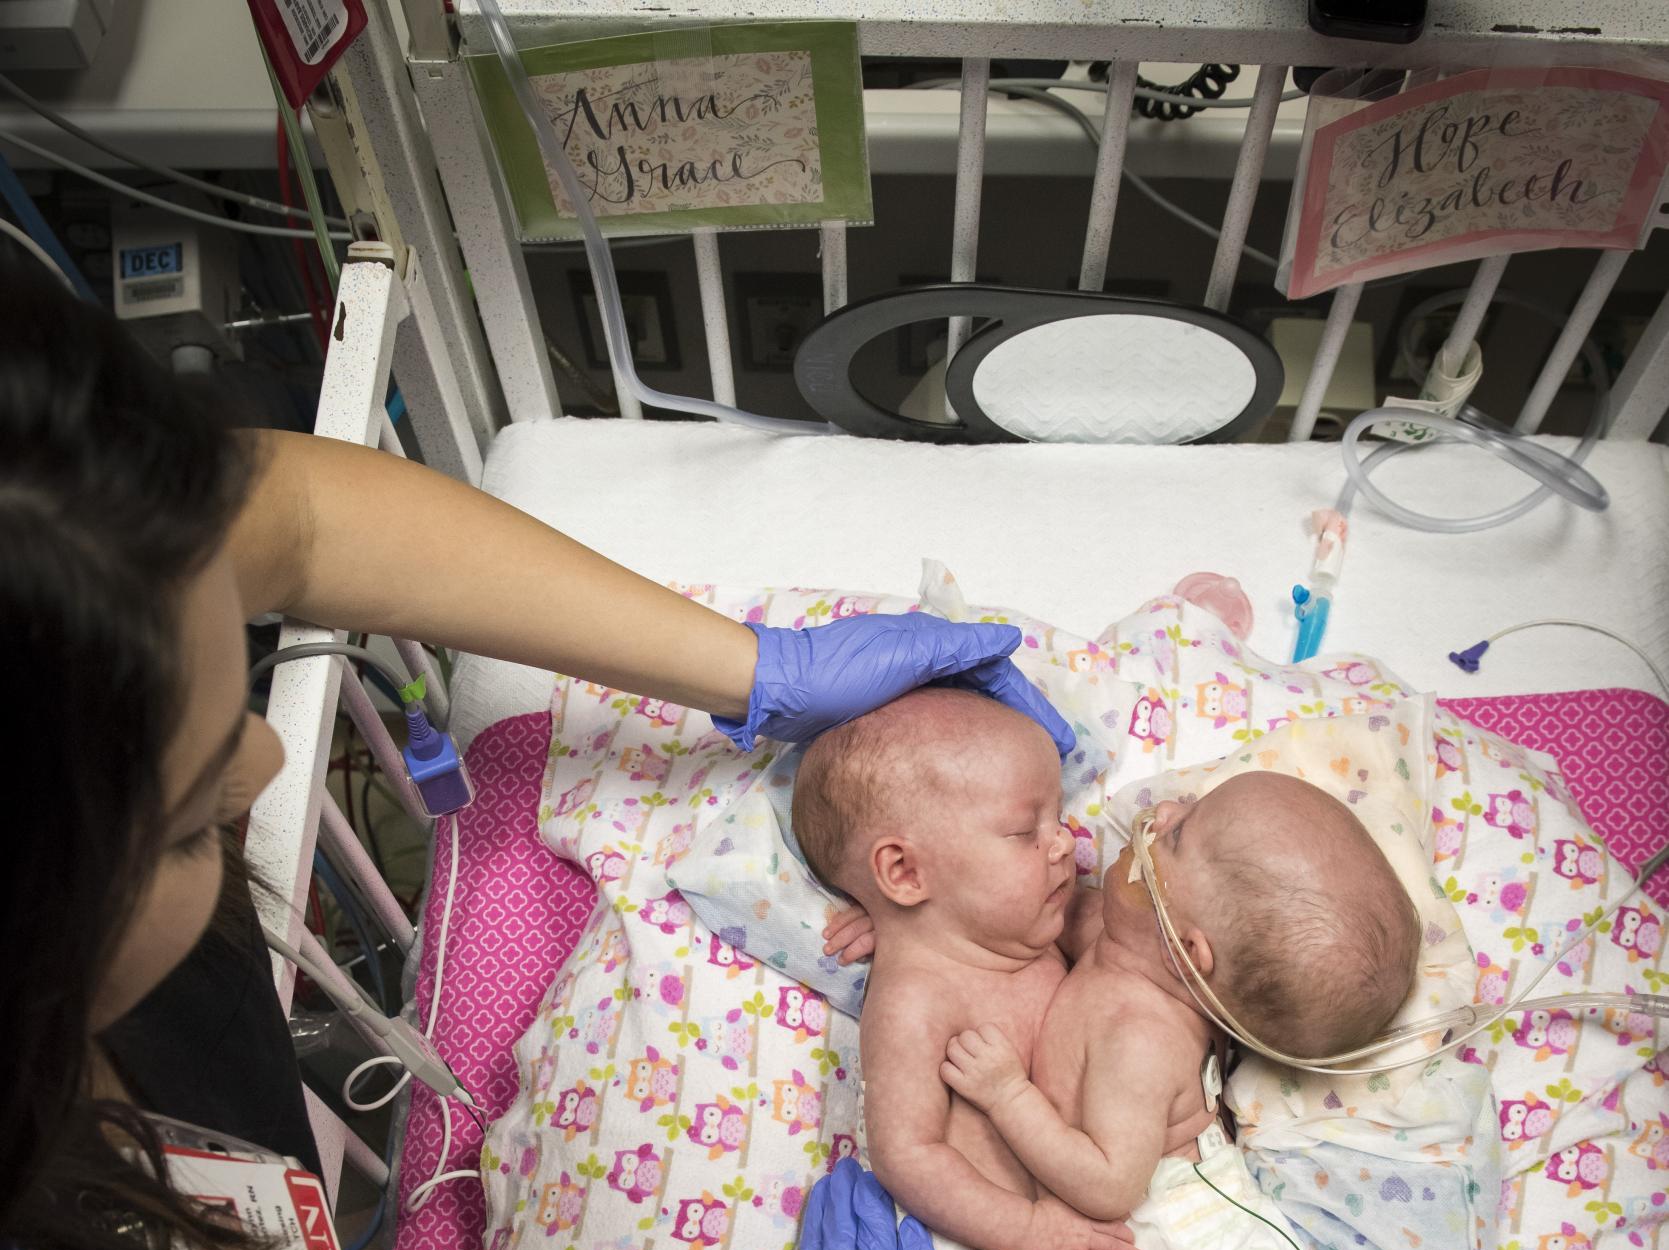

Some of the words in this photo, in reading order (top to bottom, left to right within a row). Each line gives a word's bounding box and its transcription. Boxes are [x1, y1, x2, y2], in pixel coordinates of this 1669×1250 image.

[550, 78, 779, 149] Anna
[578, 146, 806, 204] Grace
[1361, 106, 1543, 188] Hope
[1330, 158, 1621, 249] Elizabeth
[131, 251, 171, 272] DEC
[247, 1185, 257, 1203] RN
